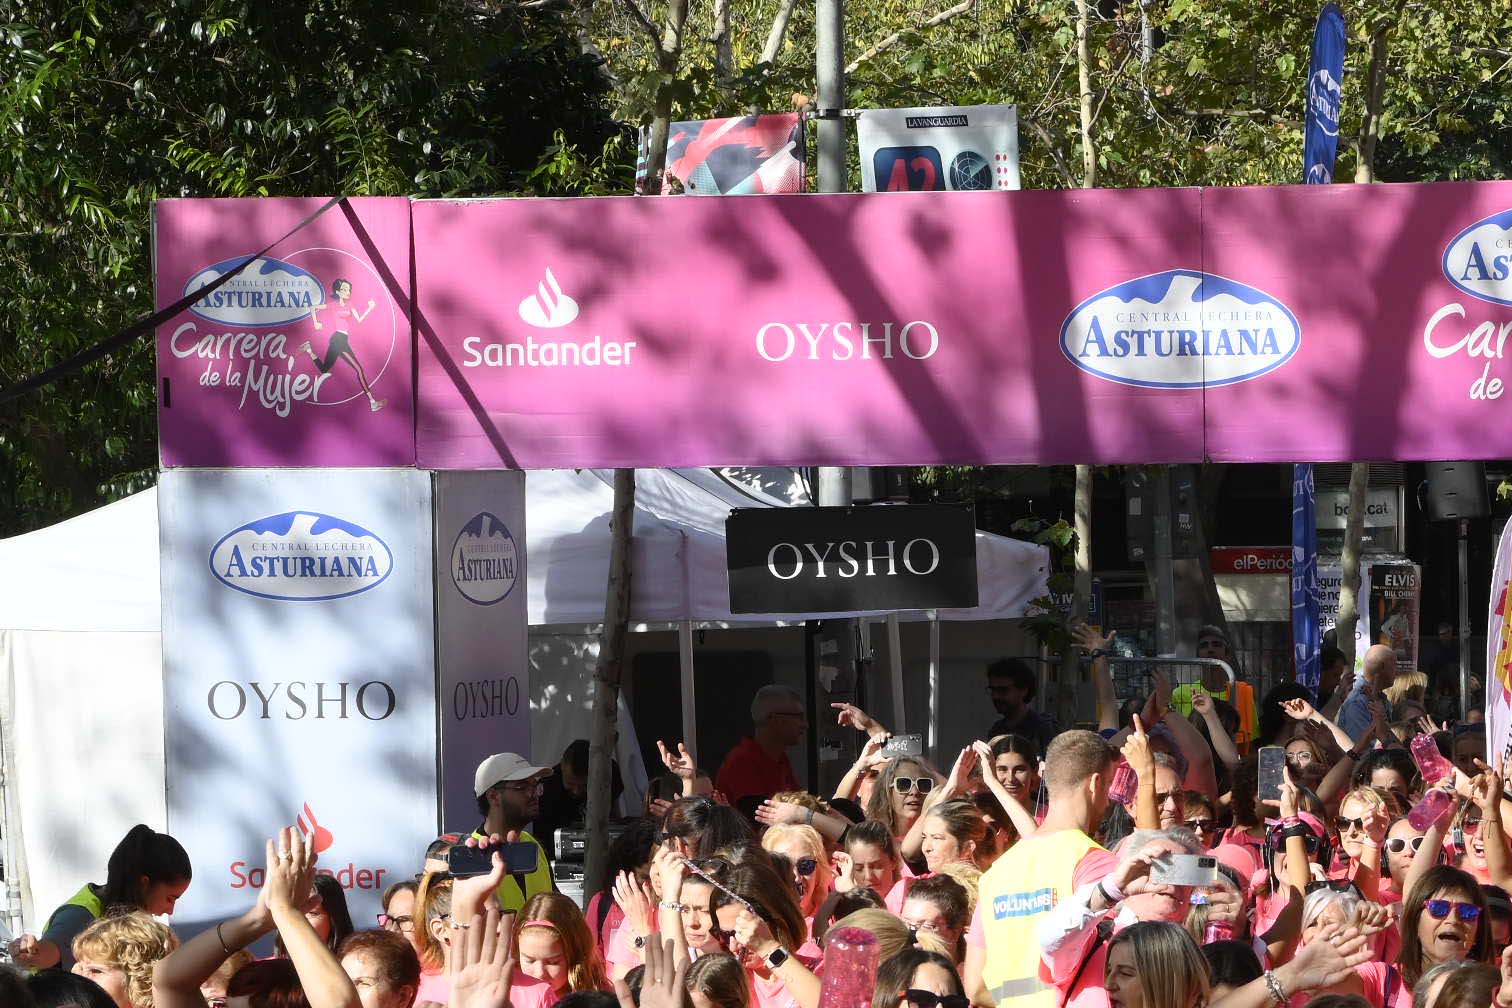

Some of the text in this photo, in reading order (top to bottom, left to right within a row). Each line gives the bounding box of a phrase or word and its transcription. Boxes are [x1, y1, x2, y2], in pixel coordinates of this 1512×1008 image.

[194, 281, 314, 309] ASTURIANA
[1078, 314, 1282, 358] ASTURIANA
[1116, 311, 1191, 323] CENTRAL
[170, 321, 288, 361] Carrera
[461, 335, 637, 368] Santander
[754, 319, 940, 363] OYSHO
[199, 356, 332, 418] de la Mujer
[1468, 360, 1505, 400] de
[223, 544, 380, 579] ASTURIANA
[251, 542, 374, 551] CENTRAL LECHERA
[456, 549, 515, 583] ASTURIANA
[767, 538, 941, 581] OYSHO
[1384, 574, 1416, 587] ELVIS
[206, 680, 397, 721] OYSHO
[453, 676, 520, 721] OYSHO
